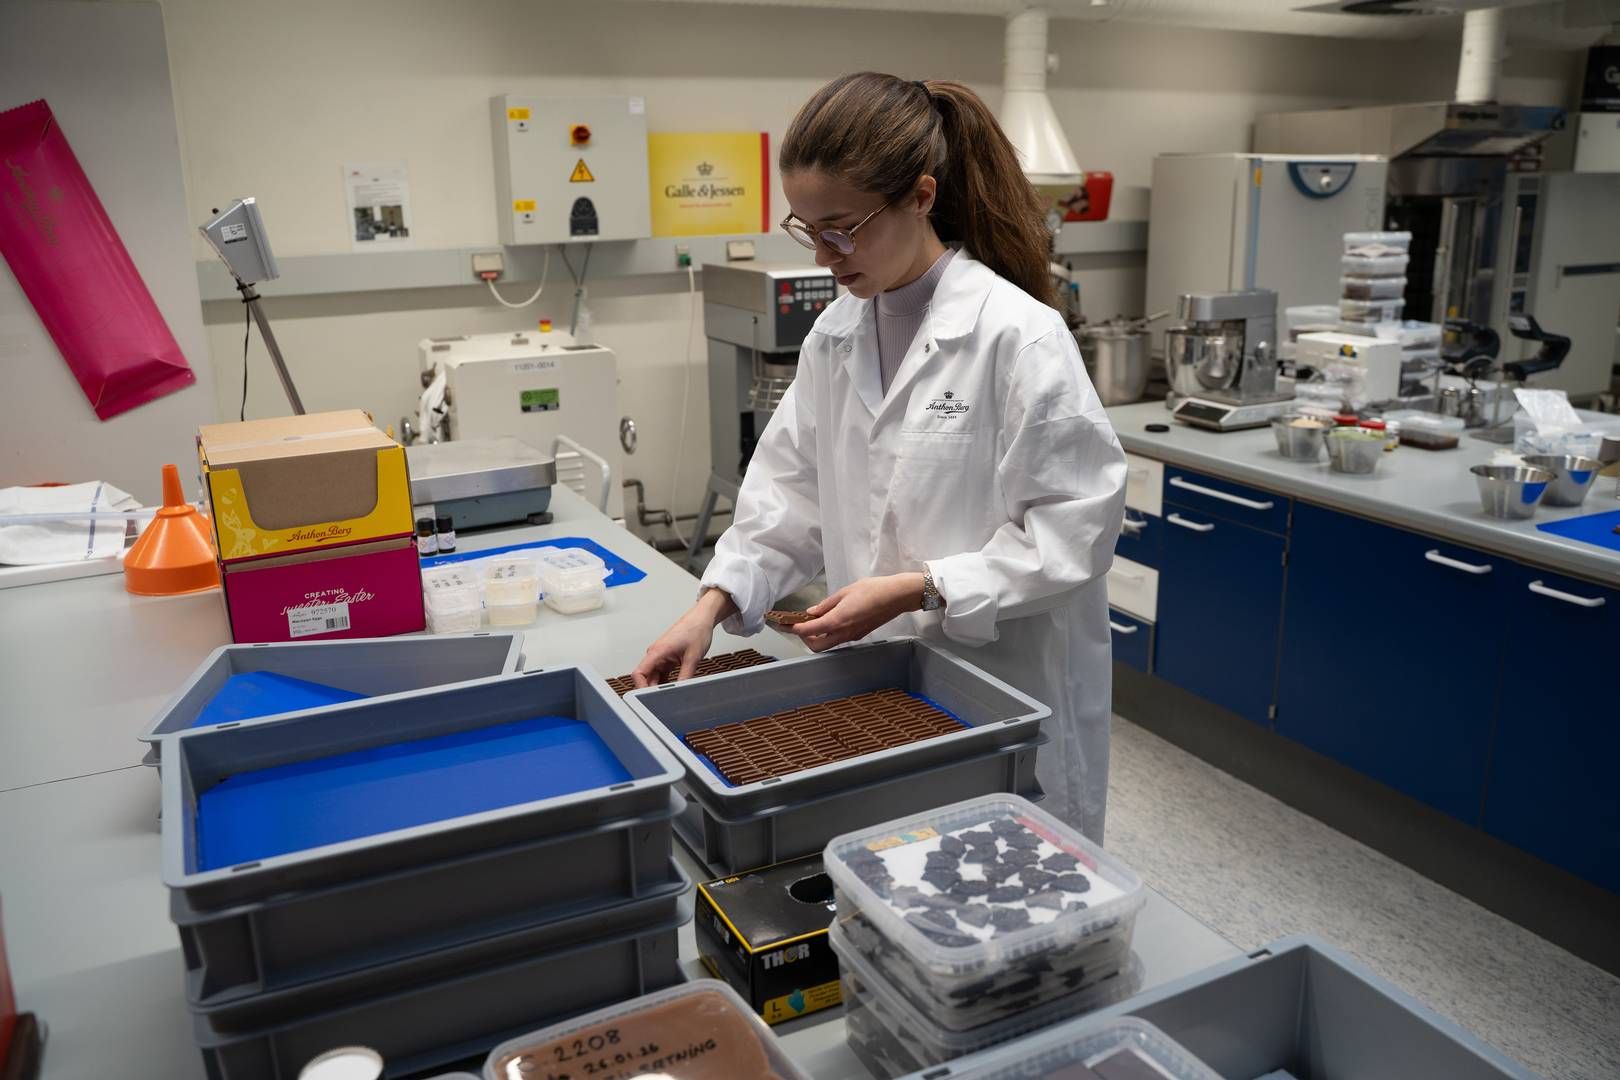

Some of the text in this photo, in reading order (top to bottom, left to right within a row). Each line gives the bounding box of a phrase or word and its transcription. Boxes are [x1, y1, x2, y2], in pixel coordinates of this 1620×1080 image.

[665, 184, 695, 198] Galle
[710, 184, 745, 198] Jessen
[926, 402, 953, 411] Anthon
[287, 525, 352, 542] Anthon Berg
[304, 588, 345, 599] CREATING
[761, 943, 810, 969] THOR
[772, 1001, 781, 1012] L
[554, 1029, 620, 1062] 2208
